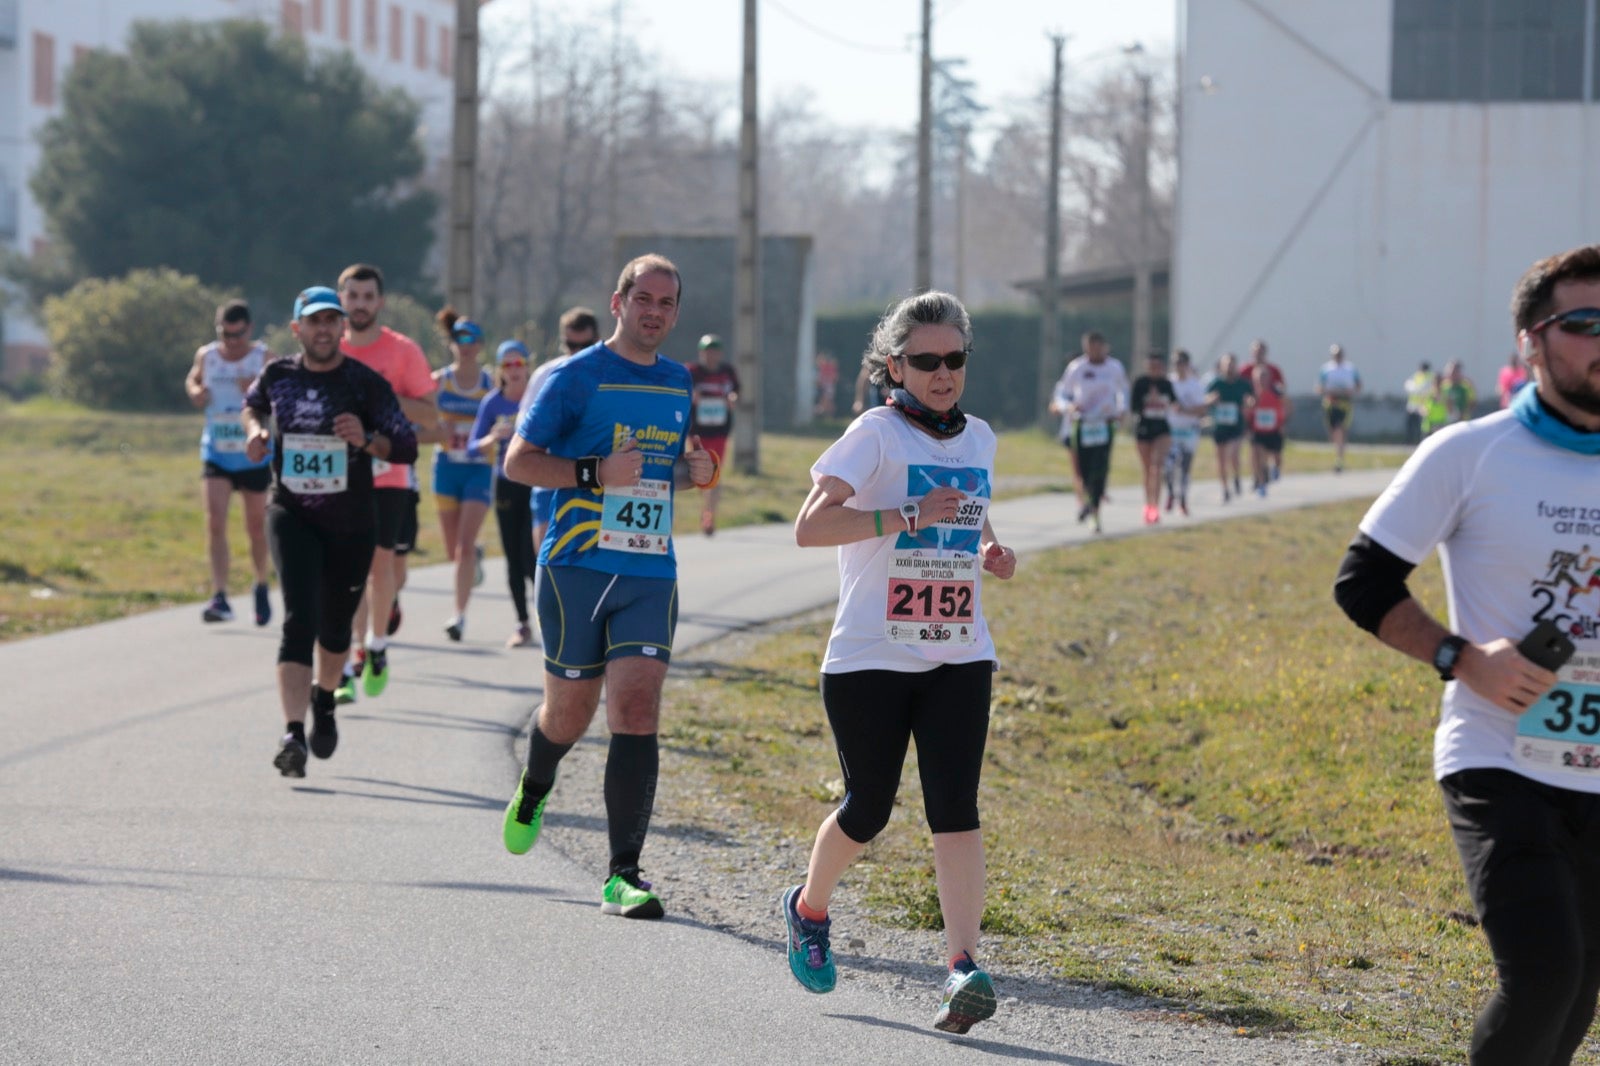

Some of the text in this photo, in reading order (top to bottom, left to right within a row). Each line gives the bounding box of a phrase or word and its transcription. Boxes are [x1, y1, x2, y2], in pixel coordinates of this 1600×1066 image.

[293, 453, 333, 474] 841
[616, 501, 663, 530] 437
[937, 515, 979, 526] iabetes
[960, 501, 983, 516] sin
[913, 559, 929, 568] GRAN
[931, 560, 952, 569] PREMIO
[892, 584, 971, 617] 2152
[1532, 587, 1556, 622] 2
[1544, 690, 1600, 735] 35
